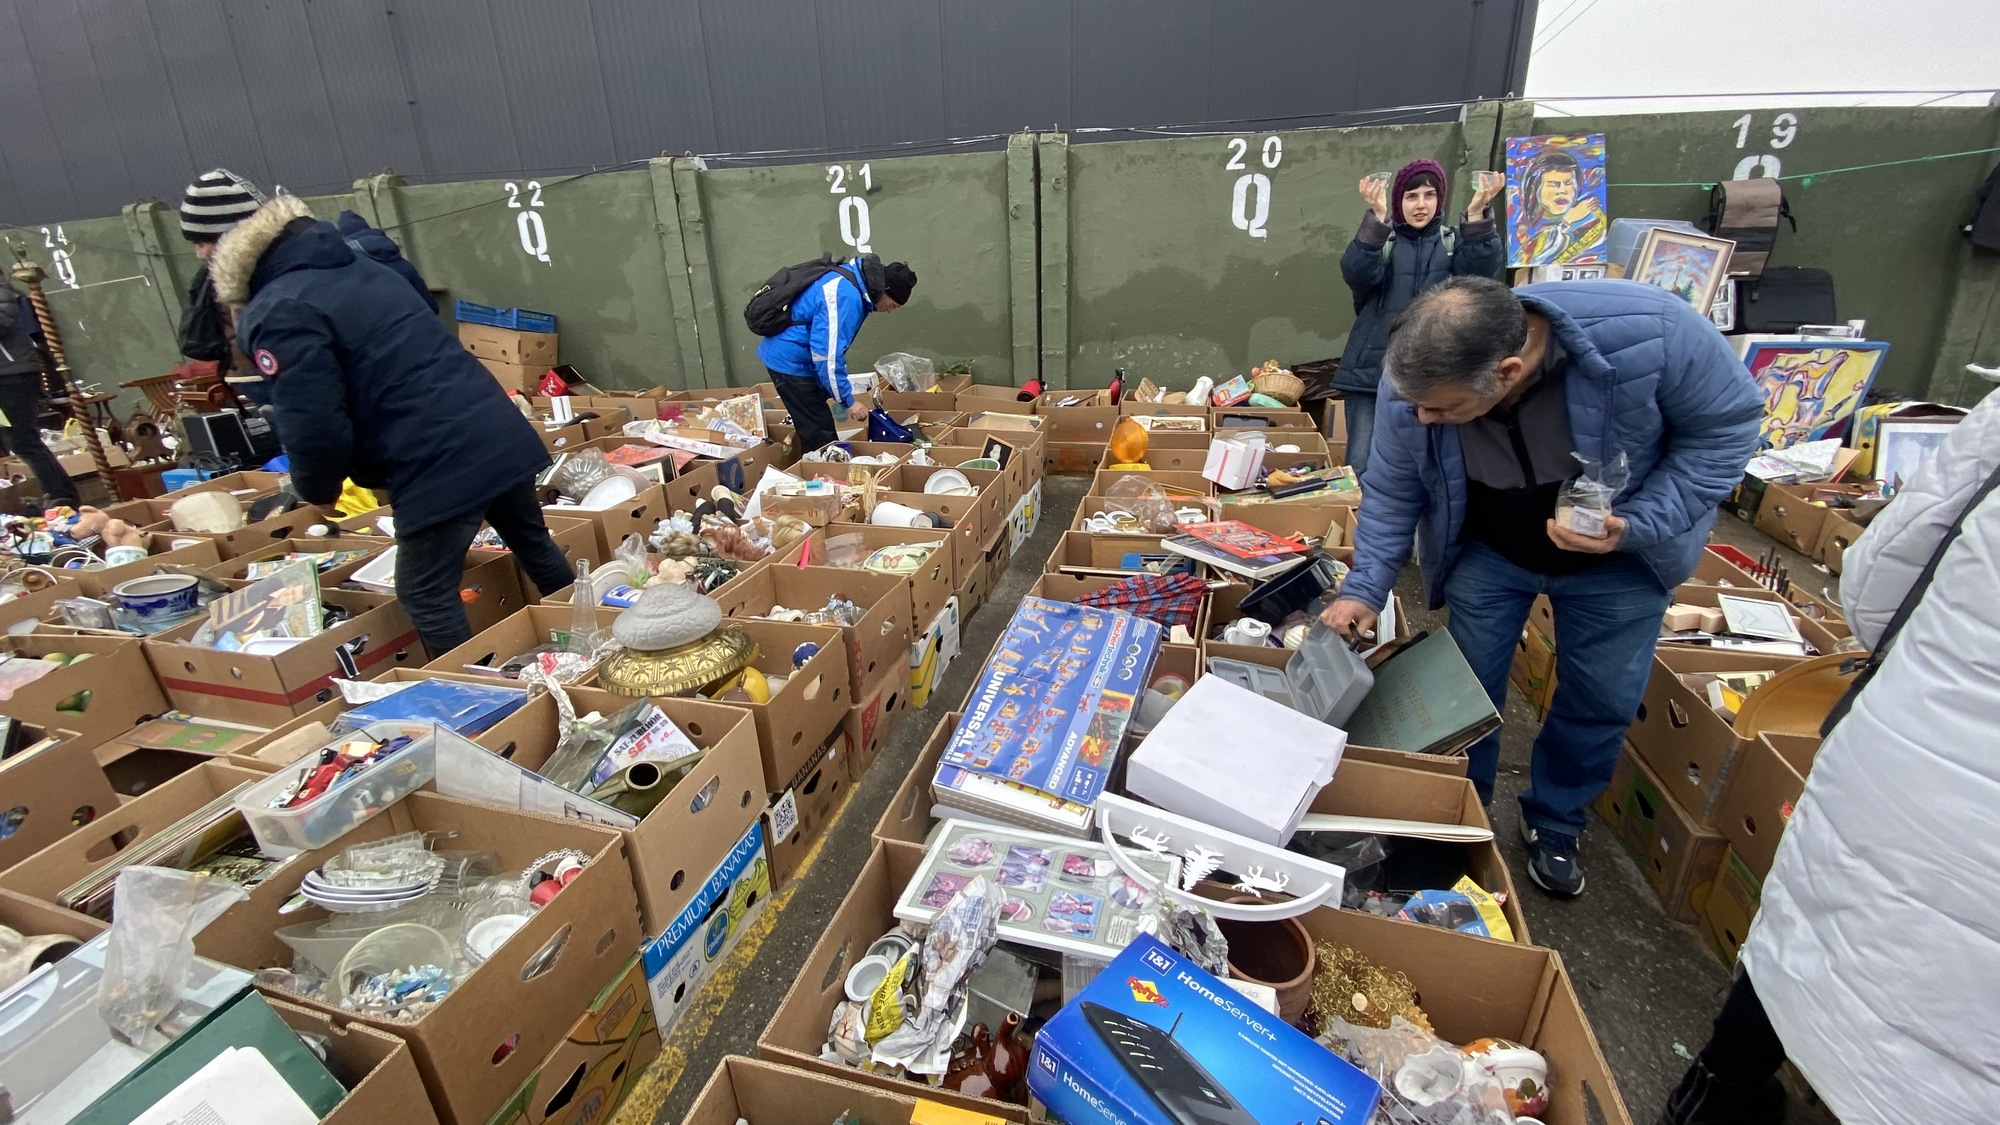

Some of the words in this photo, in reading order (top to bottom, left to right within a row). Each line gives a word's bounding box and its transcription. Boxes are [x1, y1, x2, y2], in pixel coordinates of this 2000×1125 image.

[1226, 136, 1282, 170] 20
[504, 181, 545, 208] 22
[828, 163, 872, 194] 21
[839, 196, 872, 254] Q
[1232, 173, 1271, 238] Q
[41, 225, 68, 248] 24
[517, 210, 551, 263] Q
[53, 249, 80, 289] Q
[958, 671, 1007, 747] UNIVERSAL
[613, 713, 663, 756] SAT-ZUBEHÖR
[627, 732, 654, 758] SET
[791, 742, 827, 788] BANANAS
[1049, 731, 1079, 790] ADVANCED
[656, 890, 710, 958] PREMIUM
[711, 831, 756, 894] BANANAS
[1146, 950, 1172, 971] 1&1
[1177, 971, 1277, 1041] HomeServer+
[1040, 1052, 1057, 1073] 1&1
